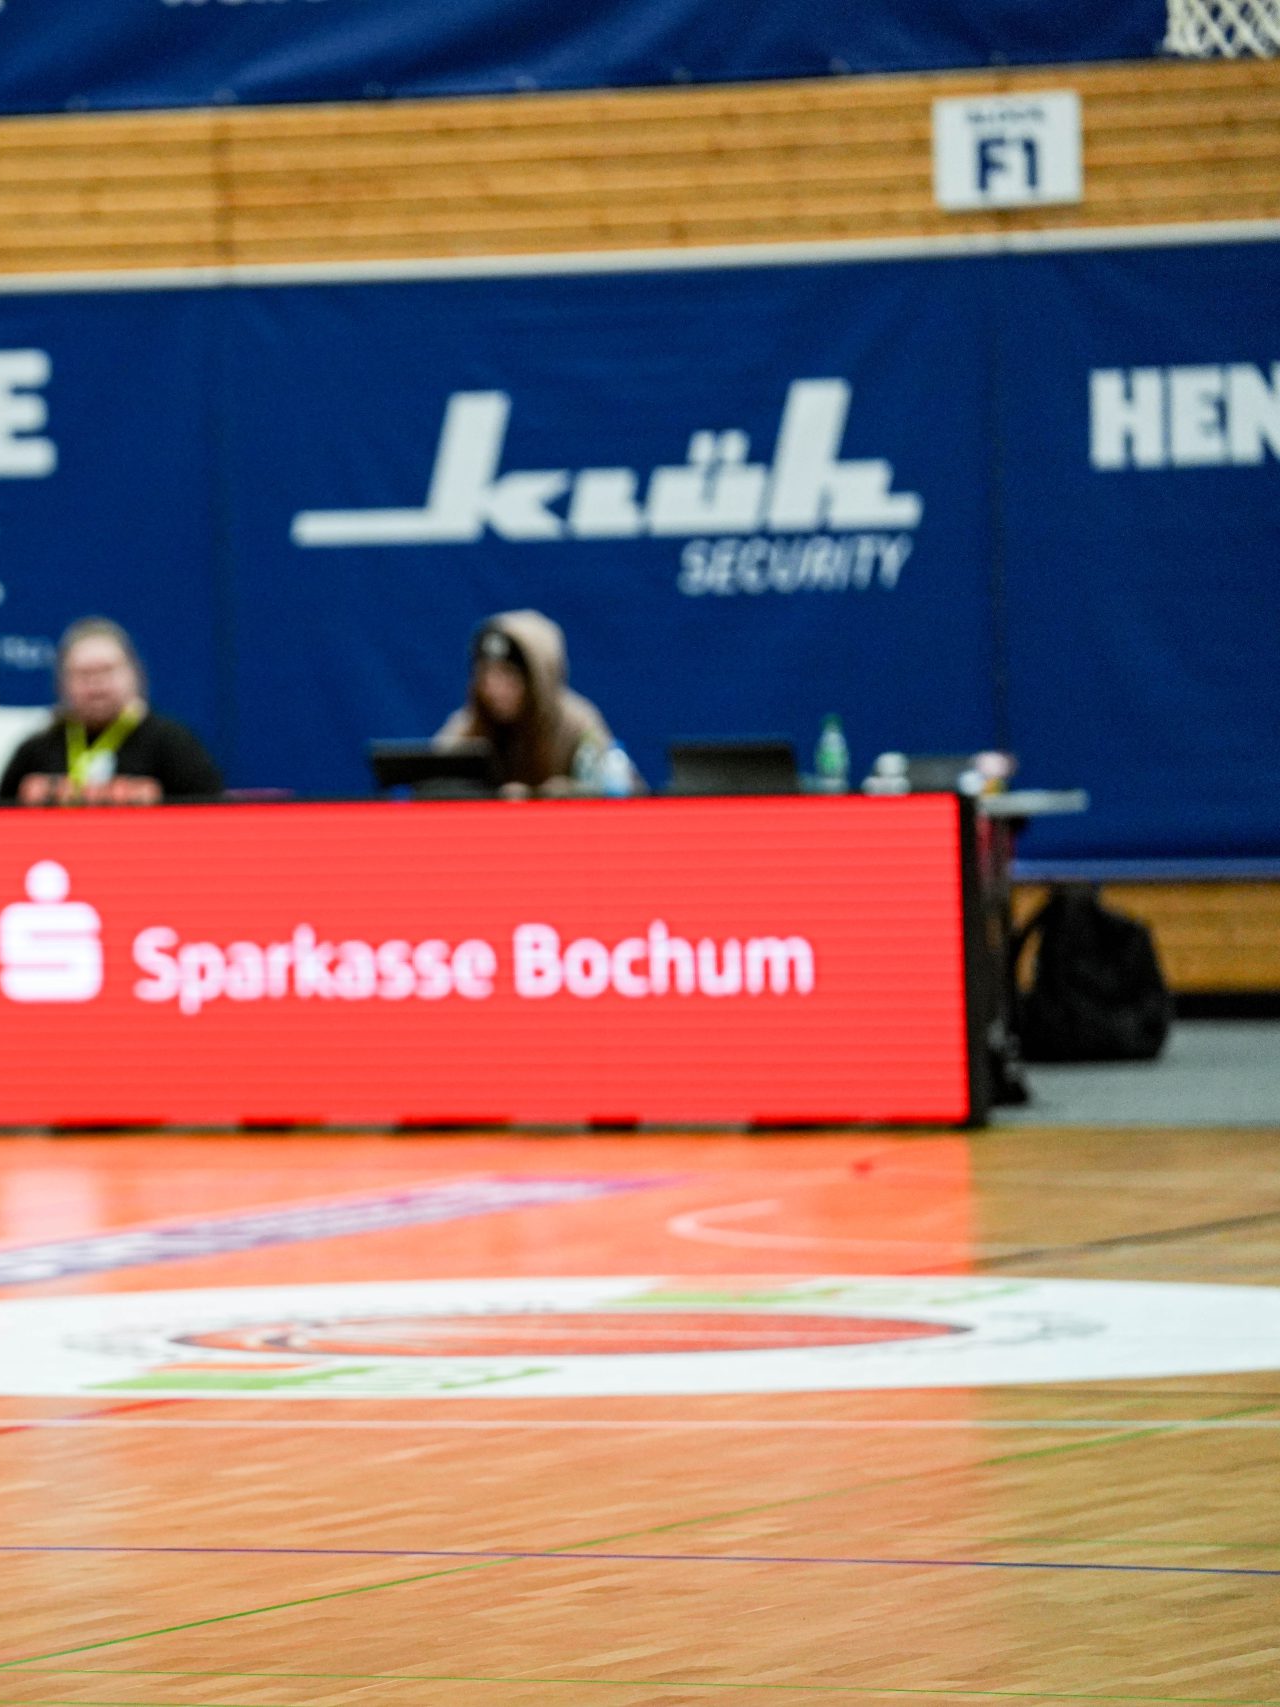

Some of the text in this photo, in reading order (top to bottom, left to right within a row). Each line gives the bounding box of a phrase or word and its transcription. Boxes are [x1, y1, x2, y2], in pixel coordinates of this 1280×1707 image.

[977, 135, 1039, 191] F1
[678, 533, 913, 597] SECURITY
[132, 918, 815, 1015] Sparkasse Bochum
